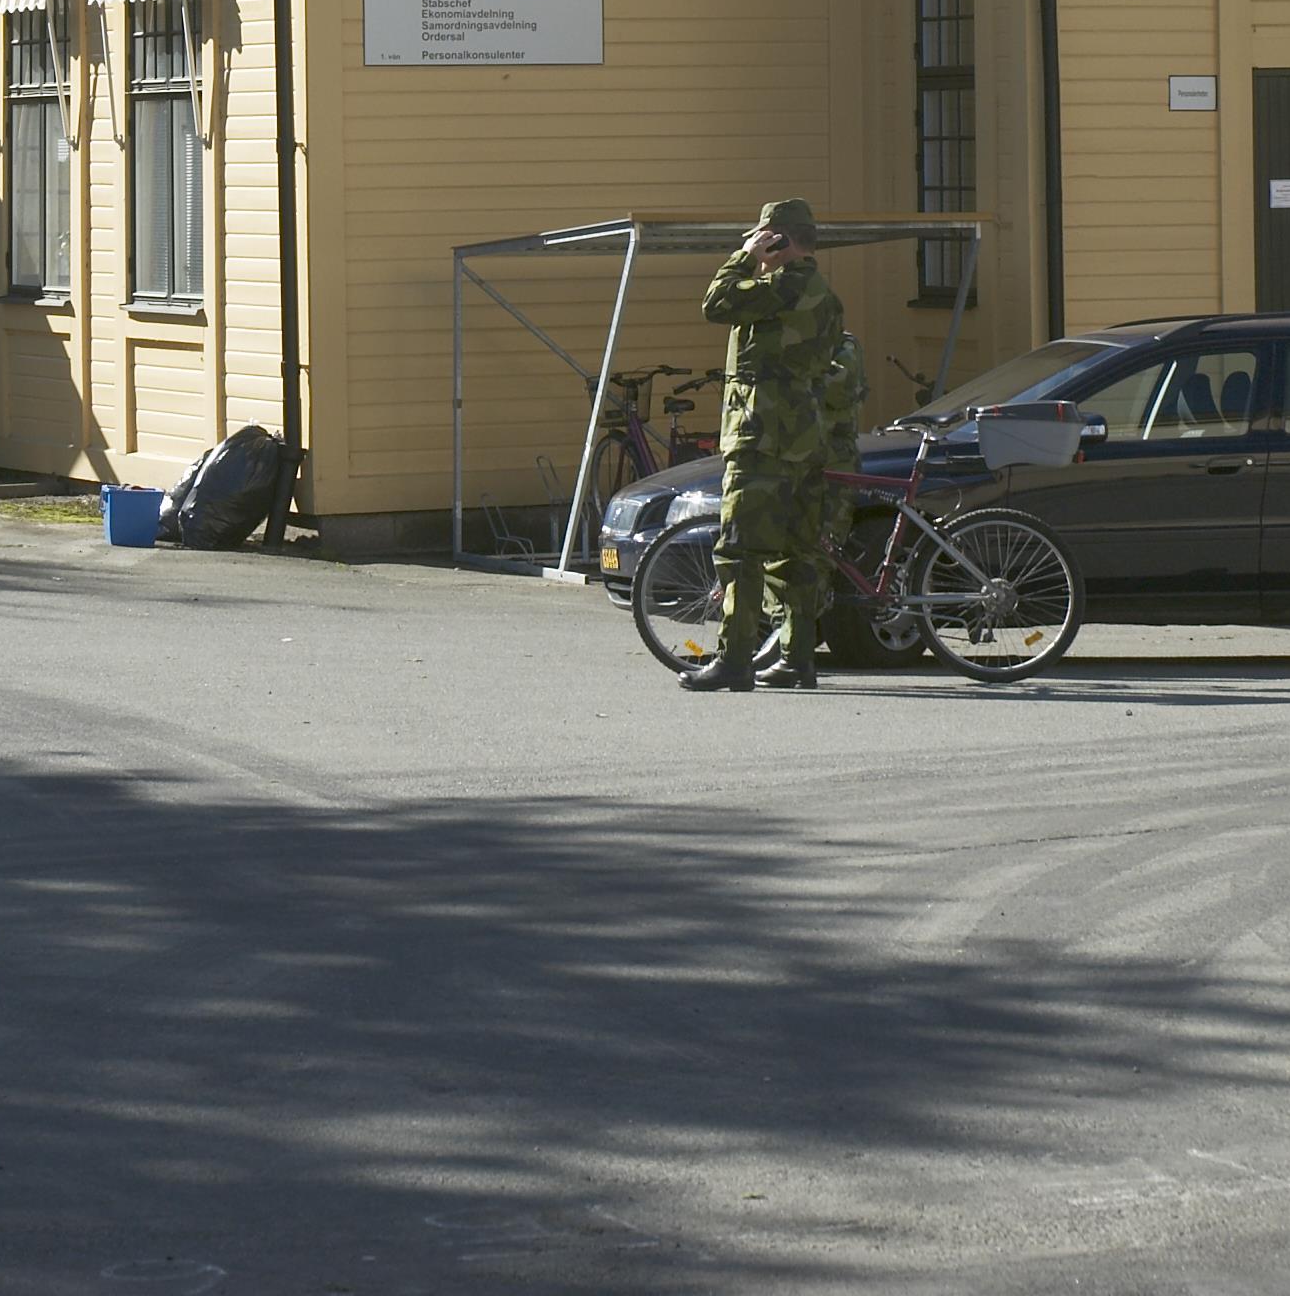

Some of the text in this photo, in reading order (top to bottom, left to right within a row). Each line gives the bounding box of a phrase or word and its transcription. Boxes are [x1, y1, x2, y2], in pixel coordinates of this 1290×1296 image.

[421, 9, 515, 20] Ekonomiavdelning
[421, 20, 537, 31] Samordningsavdelning
[421, 31, 465, 42] Ordersal
[421, 49, 525, 61] Personalkonsulenter
